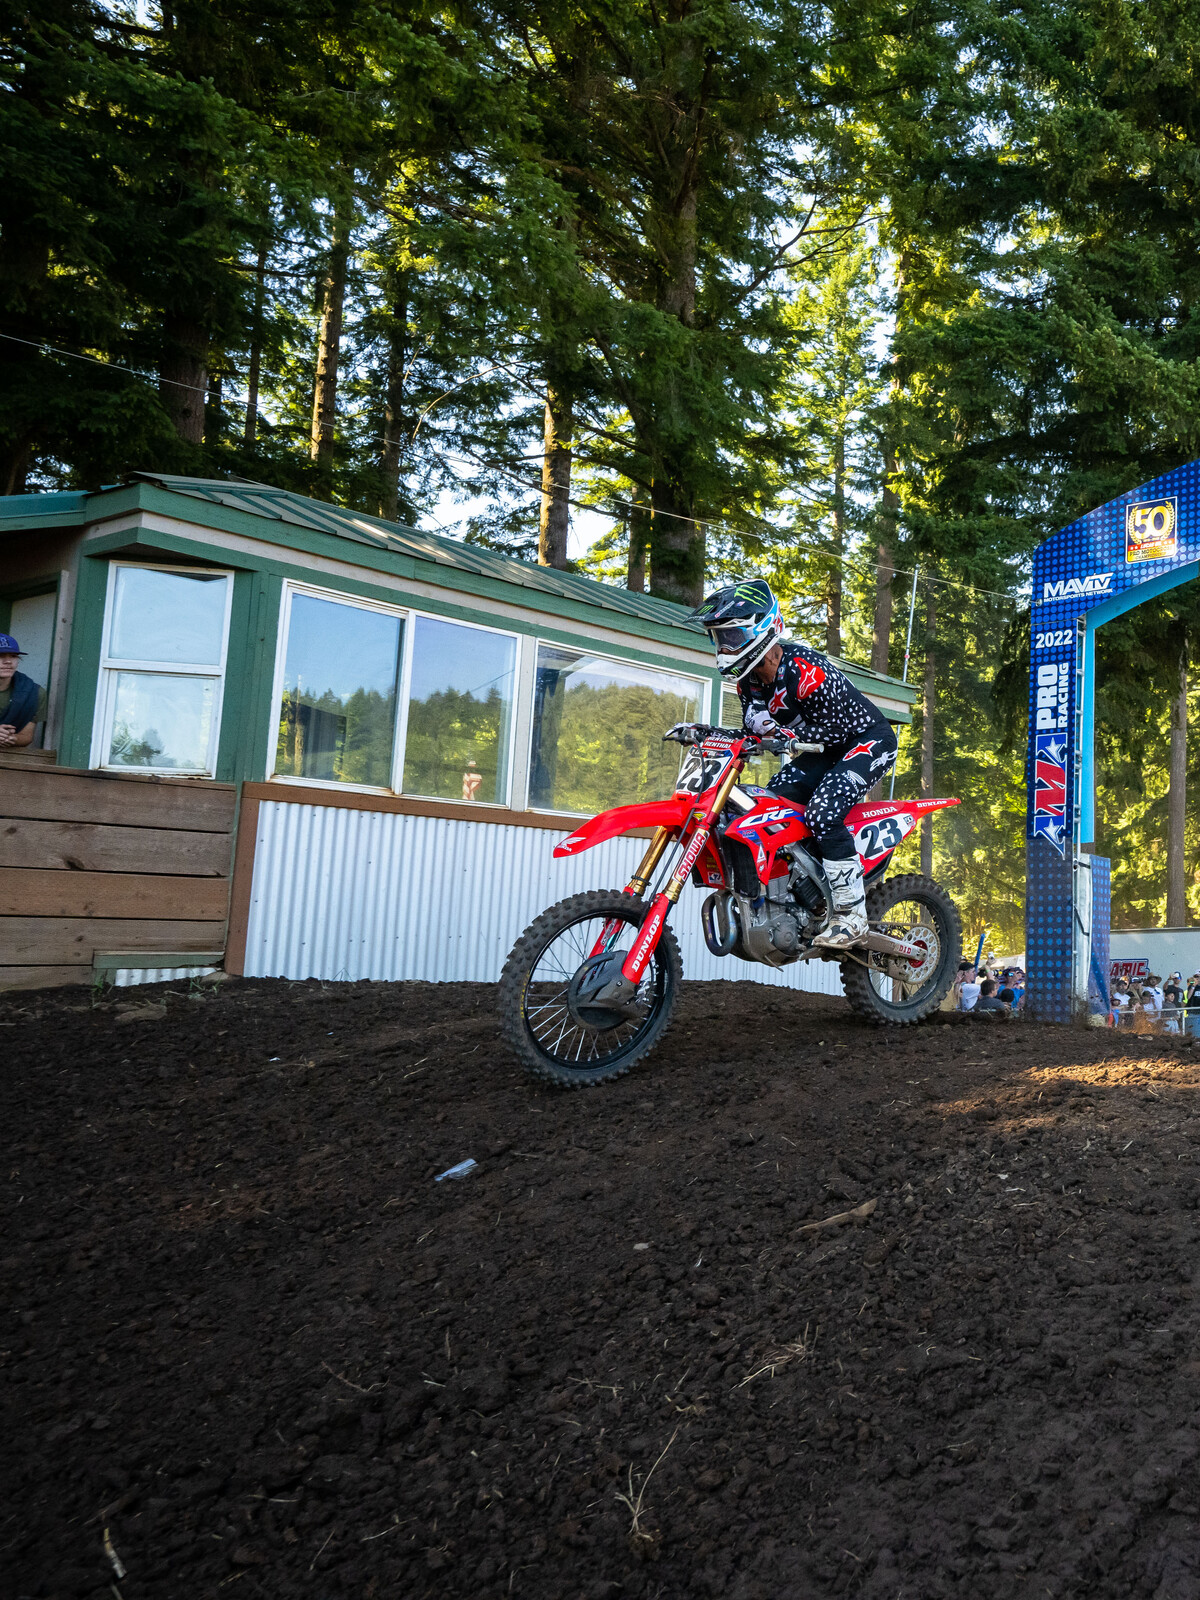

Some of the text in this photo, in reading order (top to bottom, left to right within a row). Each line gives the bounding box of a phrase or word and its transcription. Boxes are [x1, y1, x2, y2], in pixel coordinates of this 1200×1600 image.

[1134, 505, 1171, 539] 50
[1043, 588, 1114, 603] MOTORSPORTS NETWORK
[1035, 629, 1073, 649] 2022
[1036, 663, 1058, 731] PRO
[1057, 662, 1070, 729] RACING
[704, 741, 732, 749] RENTHAL
[676, 757, 722, 793] 23
[738, 808, 795, 829] CRF
[861, 806, 898, 819] HONDA
[916, 800, 948, 808] DUNLOP
[678, 831, 707, 881] SHOWA
[860, 818, 903, 860] 23
[631, 914, 661, 973] DUNLOP
